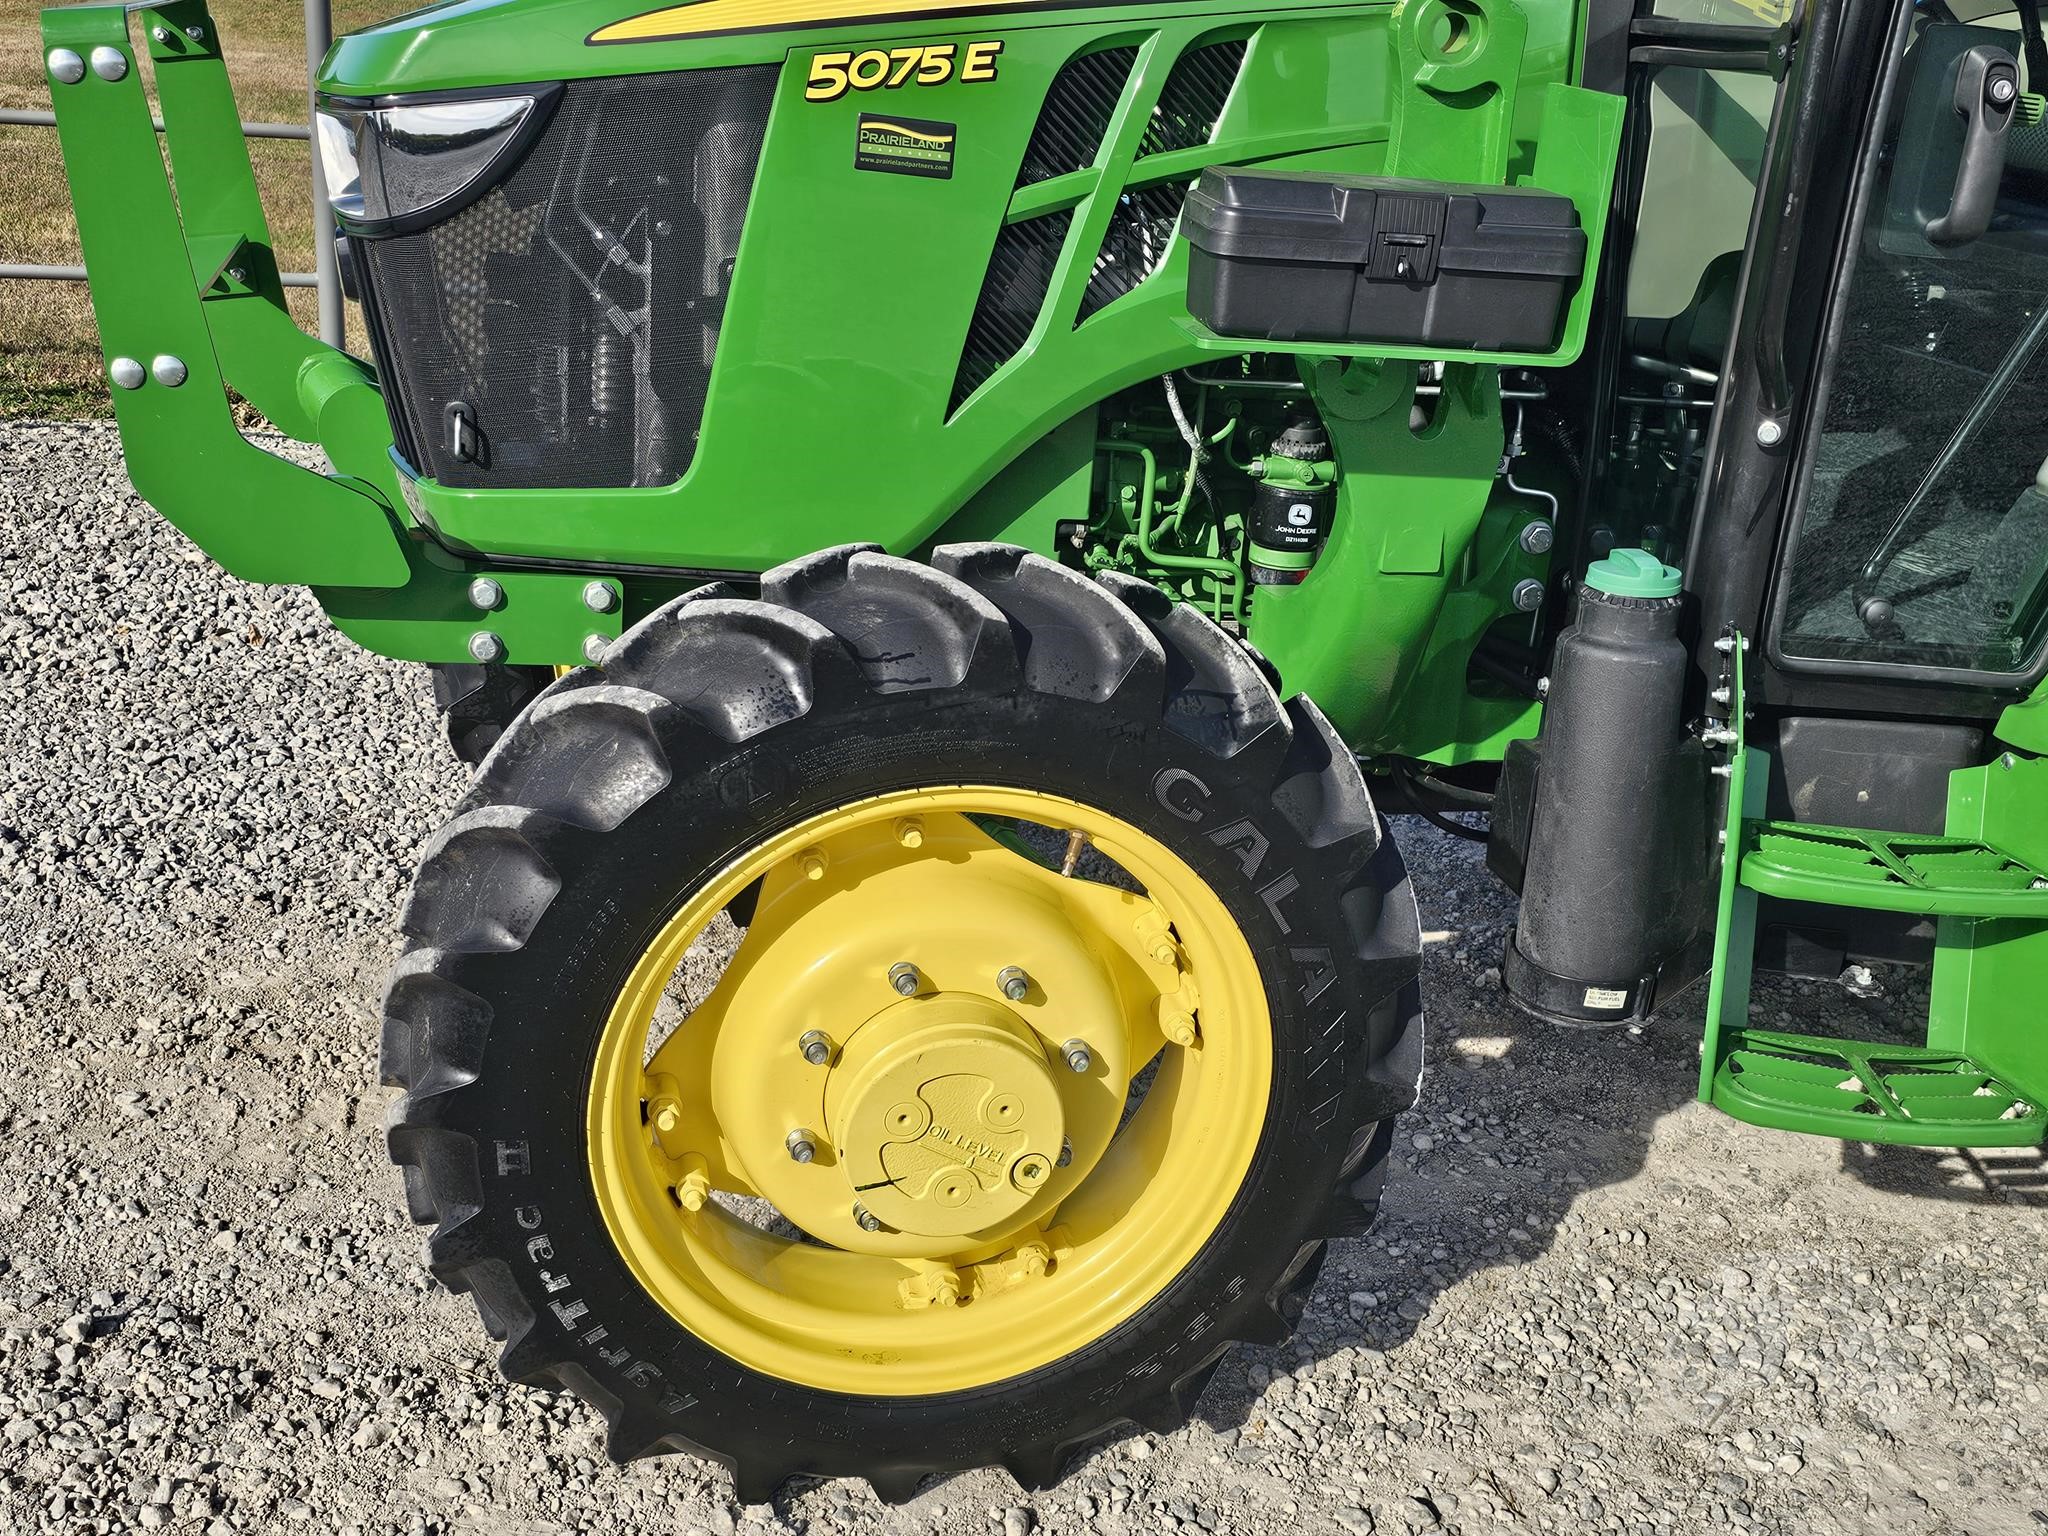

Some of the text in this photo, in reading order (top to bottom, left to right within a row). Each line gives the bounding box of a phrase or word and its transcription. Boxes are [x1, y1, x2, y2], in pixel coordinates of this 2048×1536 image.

[804, 39, 1005, 103] 5075 E
[859, 129, 945, 151] PRAIRIELAND
[859, 155, 949, 172] www.prairielandpartners.com
[1275, 524, 1296, 534] JOHN
[929, 1125, 1006, 1167] OIL LEVEL
